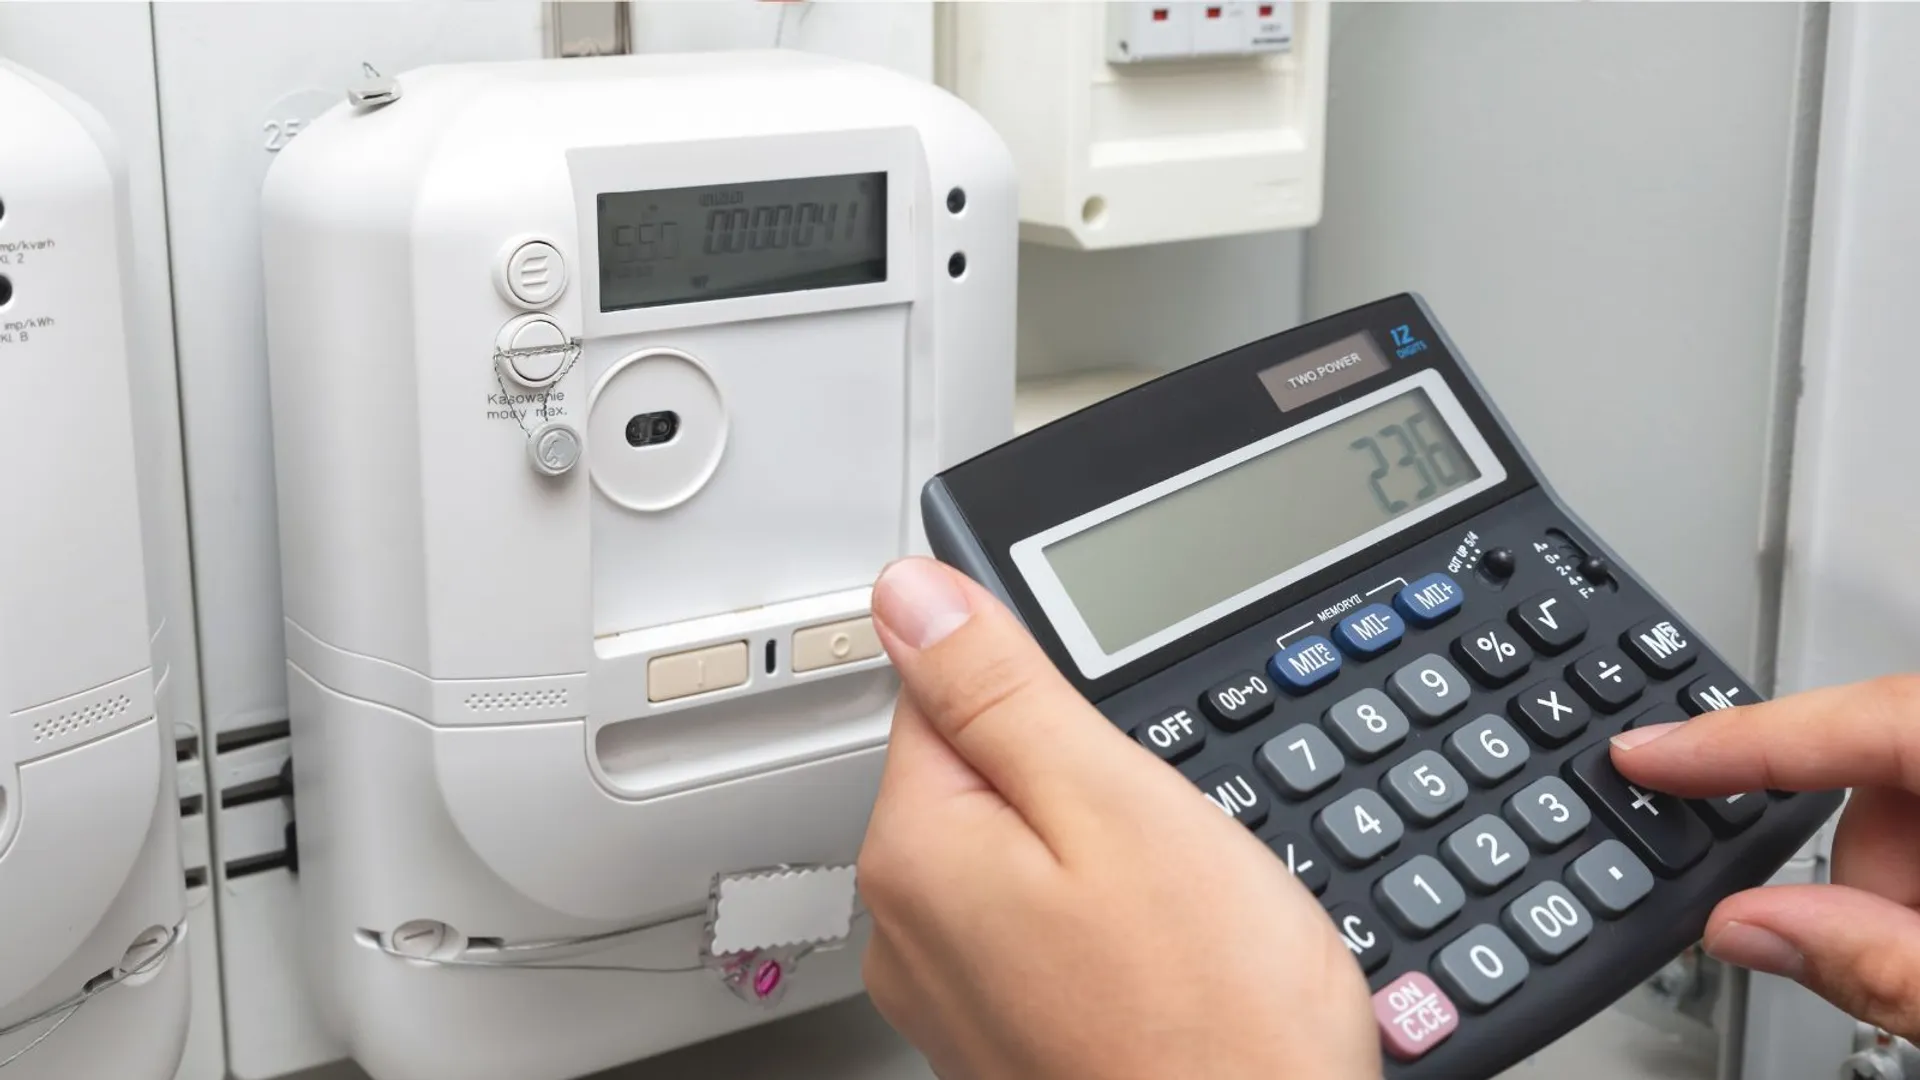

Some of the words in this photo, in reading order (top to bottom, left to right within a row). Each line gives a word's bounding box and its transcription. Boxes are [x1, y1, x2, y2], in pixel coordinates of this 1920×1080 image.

[0, 239, 55, 252] mp/kvarh
[17, 253, 24, 264] 2
[1390, 324, 1414, 346] 12
[1396, 340, 1427, 359] DIGITS
[1287, 370, 1317, 388] TWO
[1316, 352, 1362, 377] POWER
[487, 392, 565, 405] Kasowanie
[1351, 412, 1466, 514] 236
[1448, 556, 1463, 573] CUT
[1456, 544, 1469, 558] UP
[1533, 543, 1544, 553] A
[1556, 566, 1568, 576] 2
[1569, 576, 1578, 586] 4
[1578, 587, 1588, 599] F
[1420, 669, 1449, 698] 9
[1148, 710, 1193, 748] OFF
[1356, 704, 1388, 733] 8
[1288, 738, 1316, 772] 7
[1479, 729, 1509, 759] 6
[1204, 775, 1257, 817] MU
[1413, 765, 1446, 797] 5
[1354, 804, 1382, 834] 4
[1538, 793, 1570, 823] 3
[1476, 832, 1511, 866] 2
[1413, 874, 1441, 904] 1
[1530, 895, 1578, 937] 00
[1470, 944, 1504, 978] 0
[1388, 980, 1424, 1011] ON
